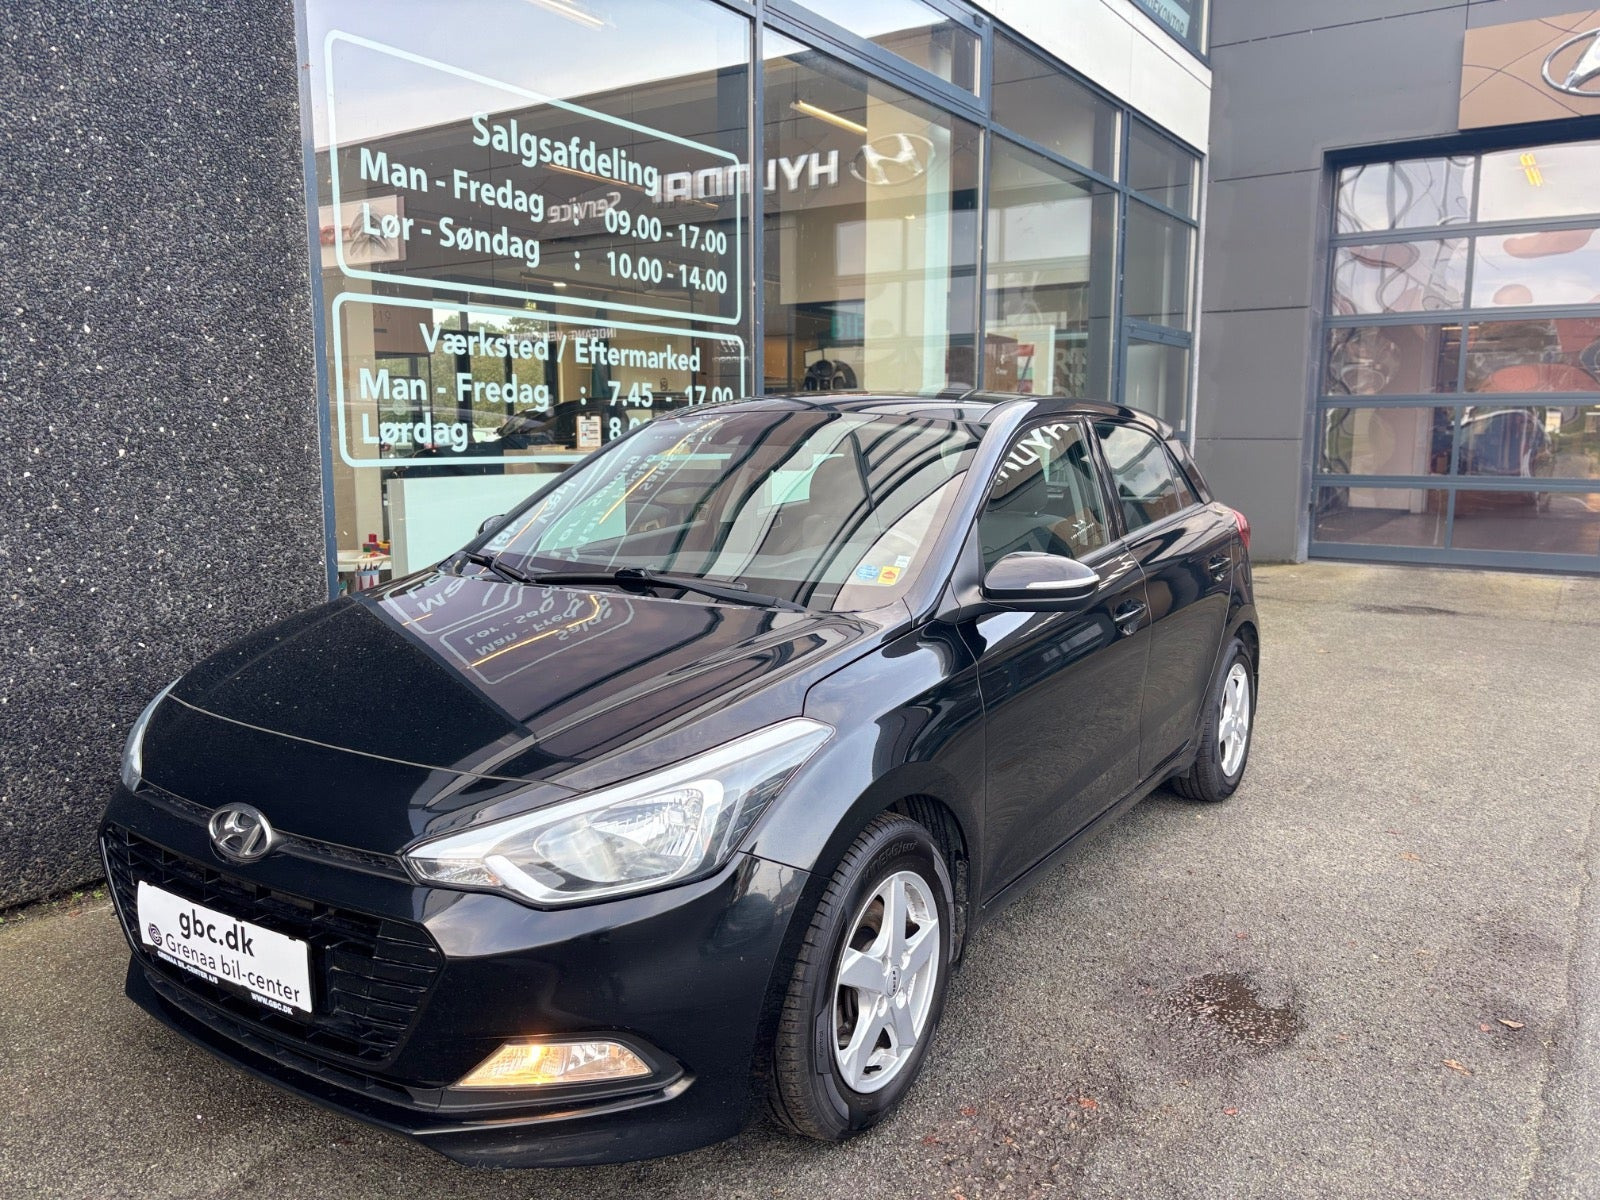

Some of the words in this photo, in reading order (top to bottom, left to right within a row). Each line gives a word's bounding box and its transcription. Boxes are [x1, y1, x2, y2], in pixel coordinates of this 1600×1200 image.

[471, 111, 659, 197] Salgsafdeling
[359, 148, 428, 192] Man
[453, 169, 545, 223] Fredag
[604, 209, 662, 243] 09.00
[678, 223, 727, 256] 17.00
[362, 203, 413, 241] Lør
[439, 217, 540, 268] Søndag
[607, 251, 662, 285] 10.00
[679, 263, 727, 295] 14.00
[418, 322, 550, 362] Værksted
[575, 337, 701, 373] Eftermarked
[359, 368, 428, 401] Man
[456, 372, 550, 412] Fredag
[608, 380, 653, 409] 7.45
[363, 413, 468, 452] Lørdag
[178, 908, 255, 957] gbc.dk
[165, 932, 217, 971] Grenaa
[220, 953, 300, 1003] bil-center
